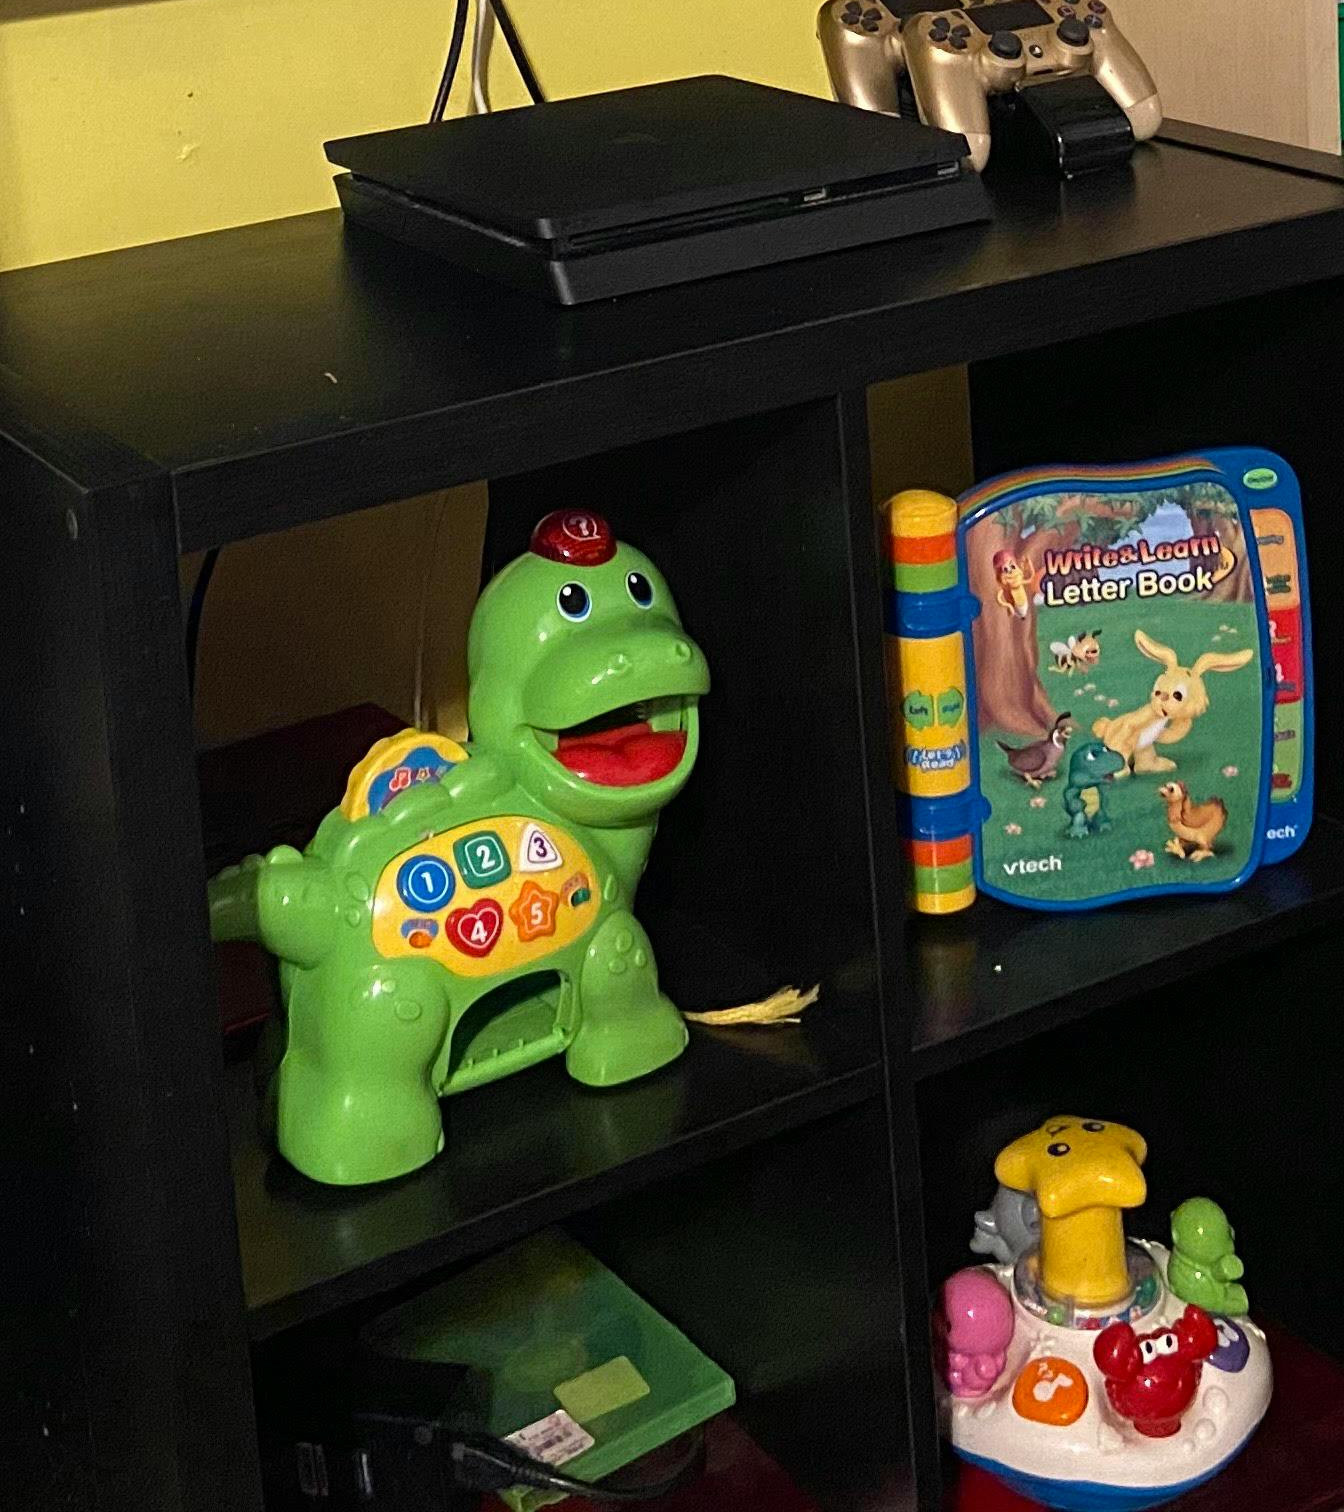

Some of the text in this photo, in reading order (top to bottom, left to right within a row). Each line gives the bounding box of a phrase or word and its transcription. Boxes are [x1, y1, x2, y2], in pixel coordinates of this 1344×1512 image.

[1046, 566, 1213, 606] Letter Book
[1266, 825, 1296, 840] ech
[476, 844, 495, 869] 2
[533, 837, 547, 858] 3
[1003, 855, 1062, 876] vtech
[421, 872, 433, 893] 1
[530, 902, 543, 926] 5
[470, 920, 487, 943] 4
